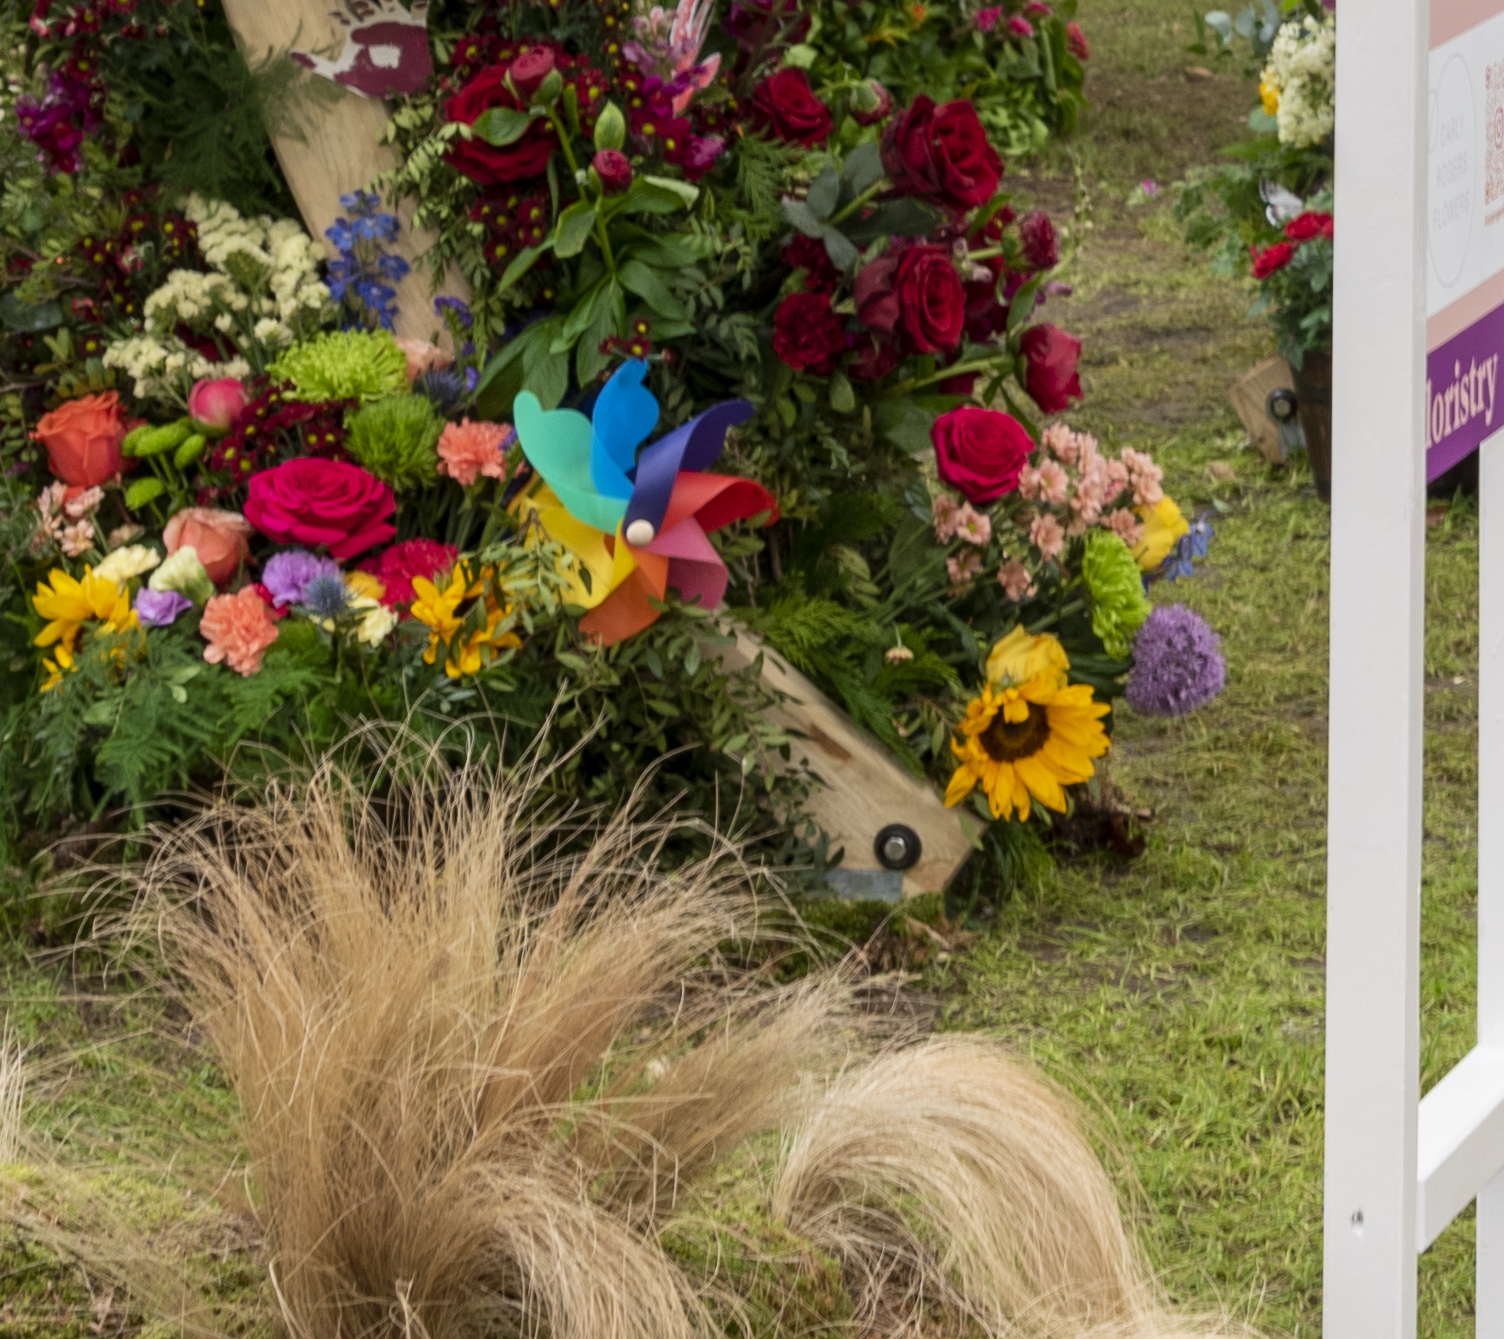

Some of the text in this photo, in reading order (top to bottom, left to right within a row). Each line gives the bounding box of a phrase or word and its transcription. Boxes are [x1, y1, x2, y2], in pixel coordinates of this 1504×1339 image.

[1440, 113, 1463, 148] CARLY
[1436, 150, 1468, 189] ROGERS
[1433, 188, 1469, 230] FLOWERS
[1425, 351, 1499, 450] loristry
